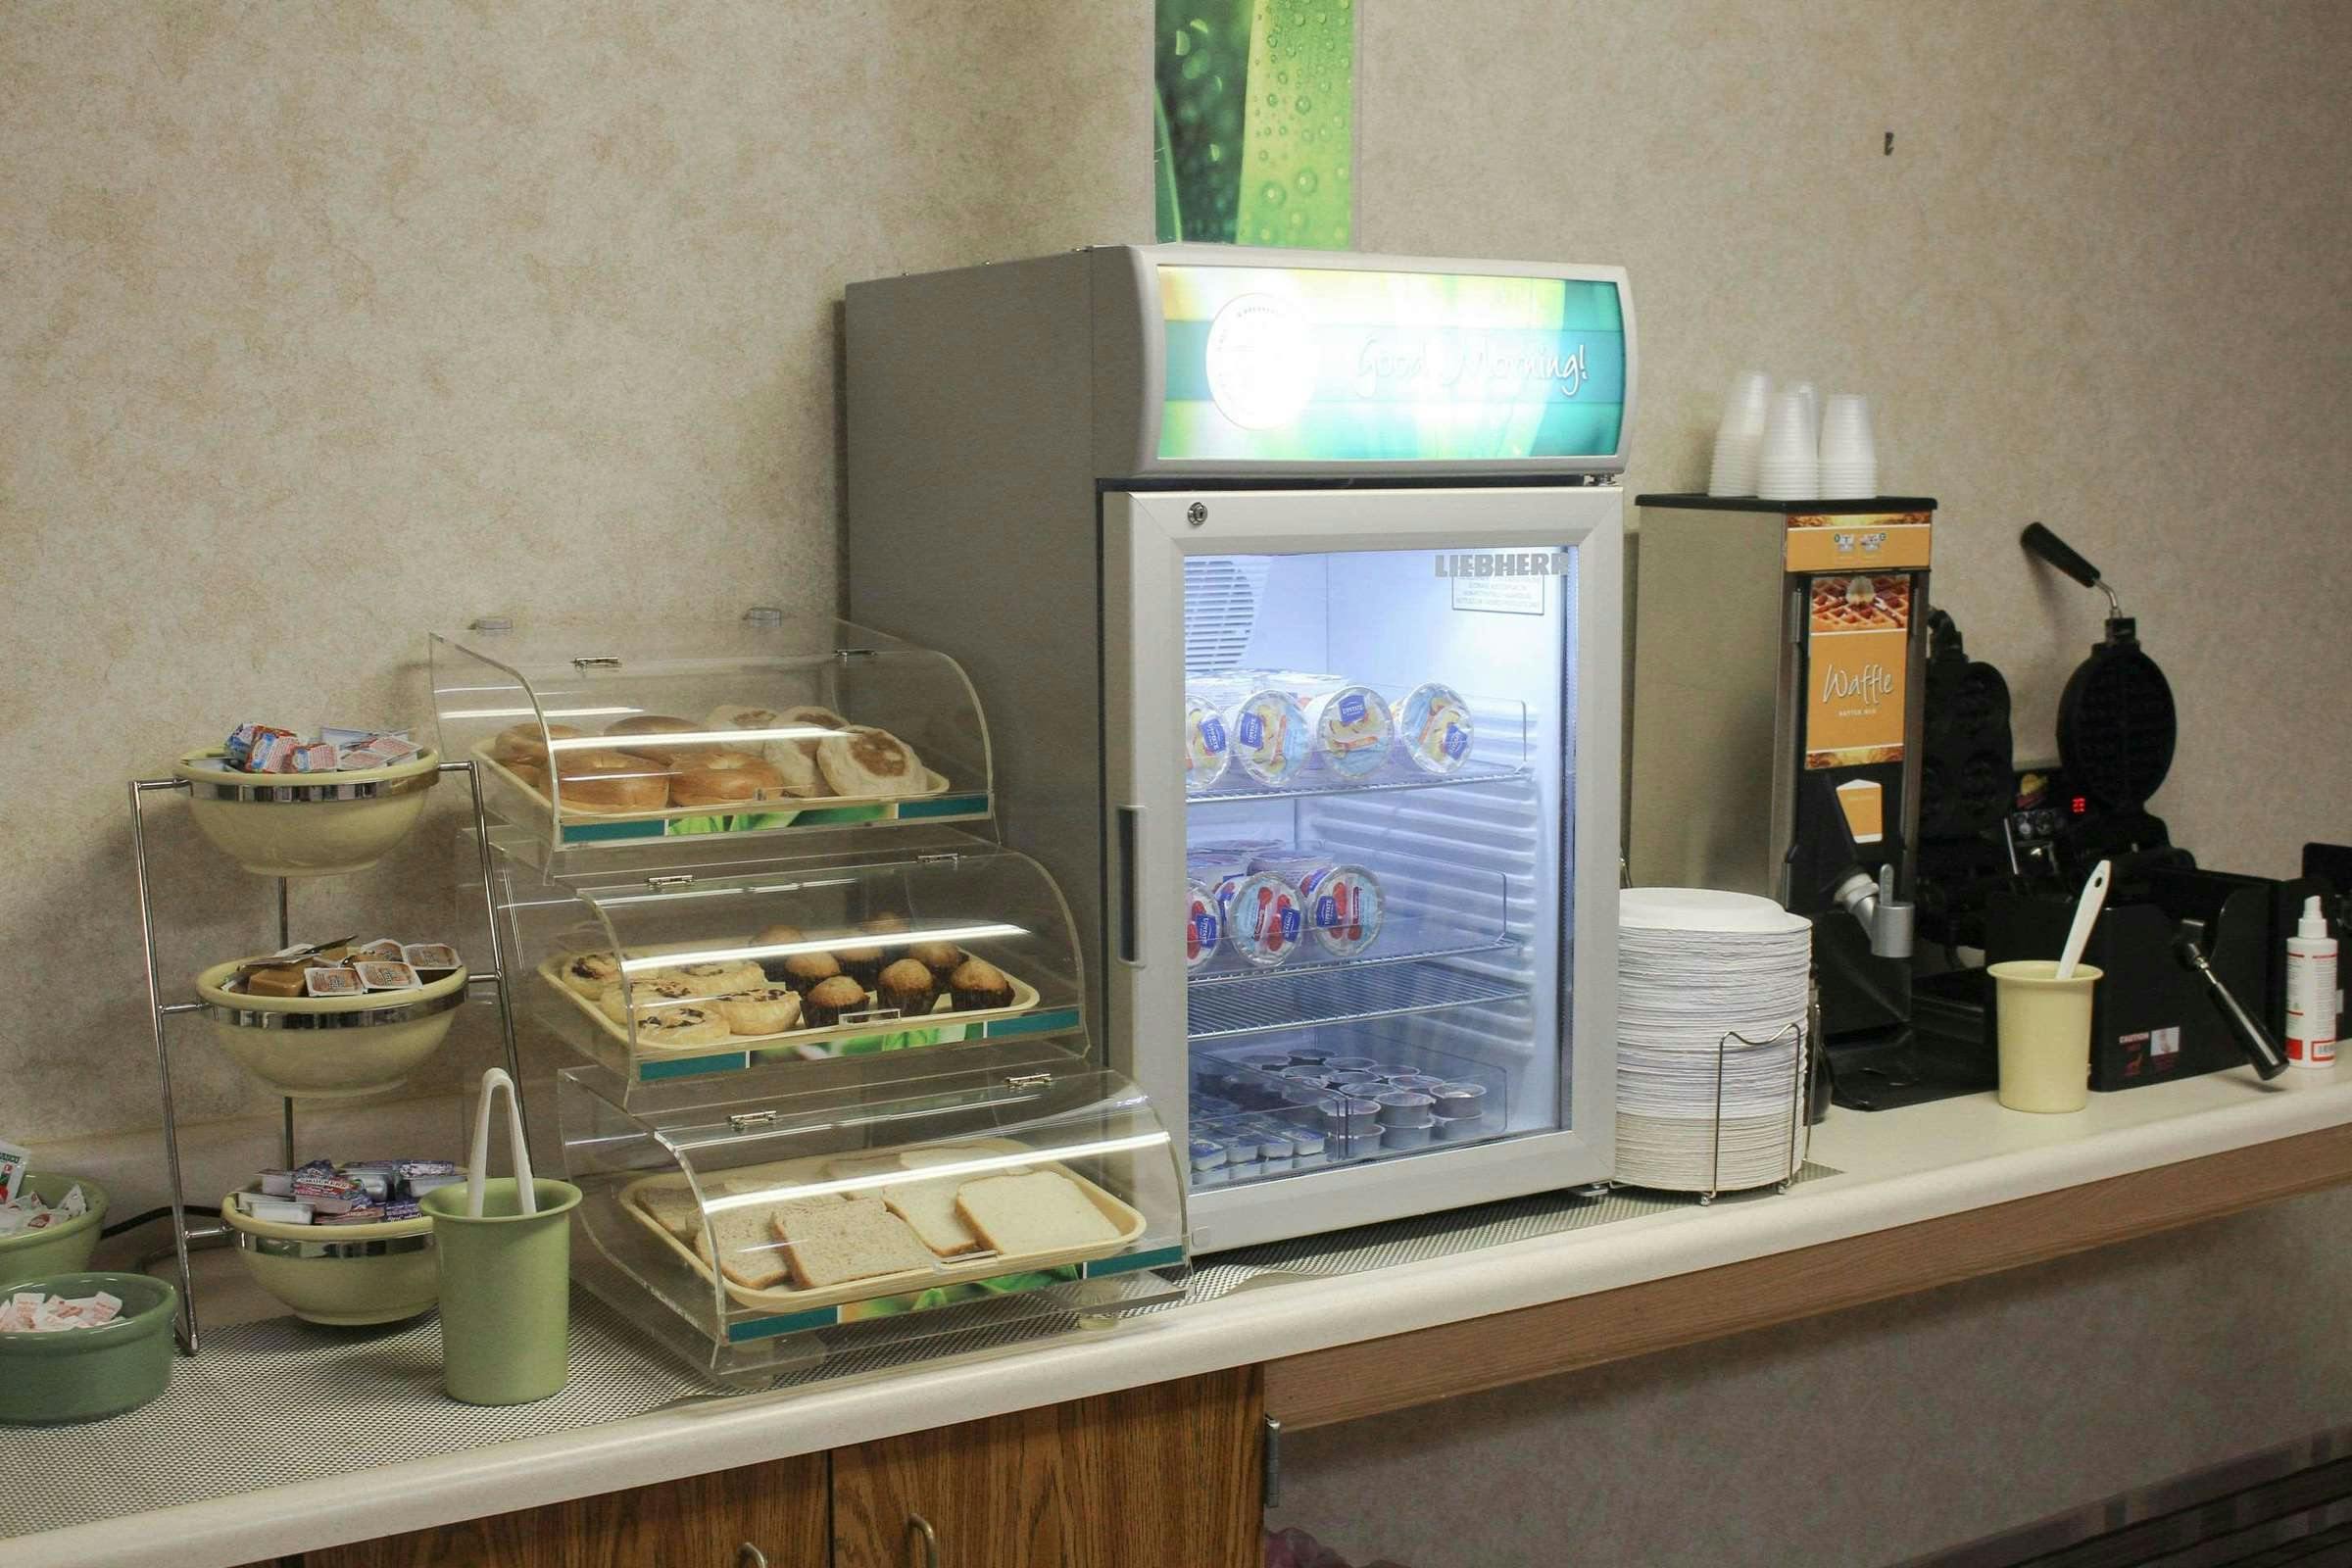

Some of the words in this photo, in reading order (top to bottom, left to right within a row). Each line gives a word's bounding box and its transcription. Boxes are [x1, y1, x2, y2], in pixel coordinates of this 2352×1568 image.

[1355, 334, 1428, 398] Good
[1441, 336, 1589, 396] Morning!
[1435, 553, 1569, 577] LIEBHERR
[1823, 663, 1893, 705] Waffle
